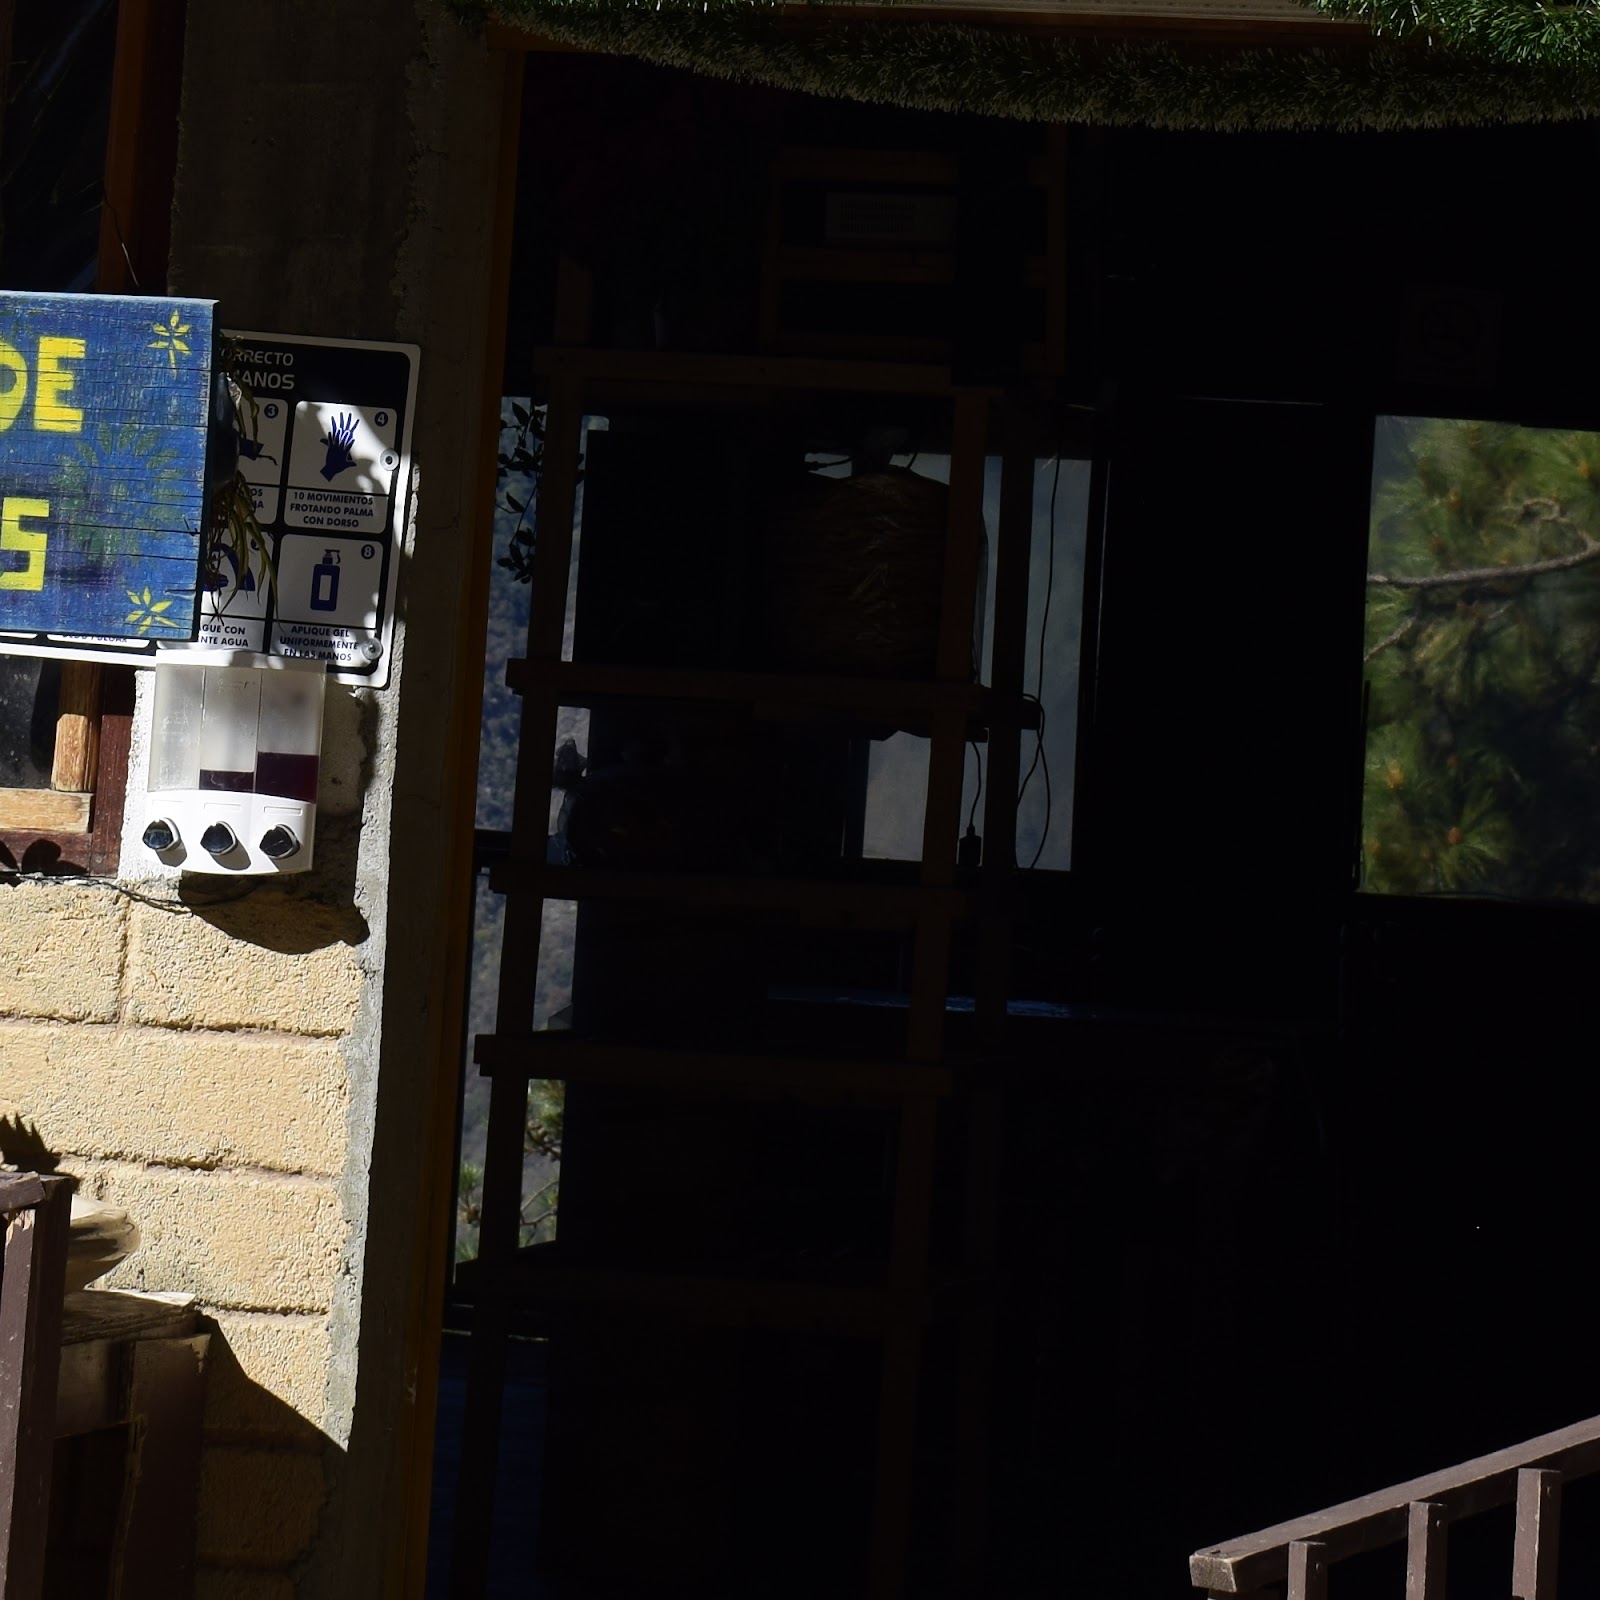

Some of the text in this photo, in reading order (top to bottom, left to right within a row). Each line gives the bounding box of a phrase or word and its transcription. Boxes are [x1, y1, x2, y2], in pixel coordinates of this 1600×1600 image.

[236, 369, 295, 390] ANOS
[293, 491, 374, 505] 10 MOVIMIENTOS
[290, 503, 374, 517] FROTANDO PALMA
[303, 515, 360, 527] CON DORSO
[224, 626, 246, 635] CON
[291, 625, 350, 637] APLIQUE GEL
[221, 637, 249, 647] AGUA
[279, 636, 360, 650] UNIFORMEMENTE
[318, 651, 352, 661] MANOS
